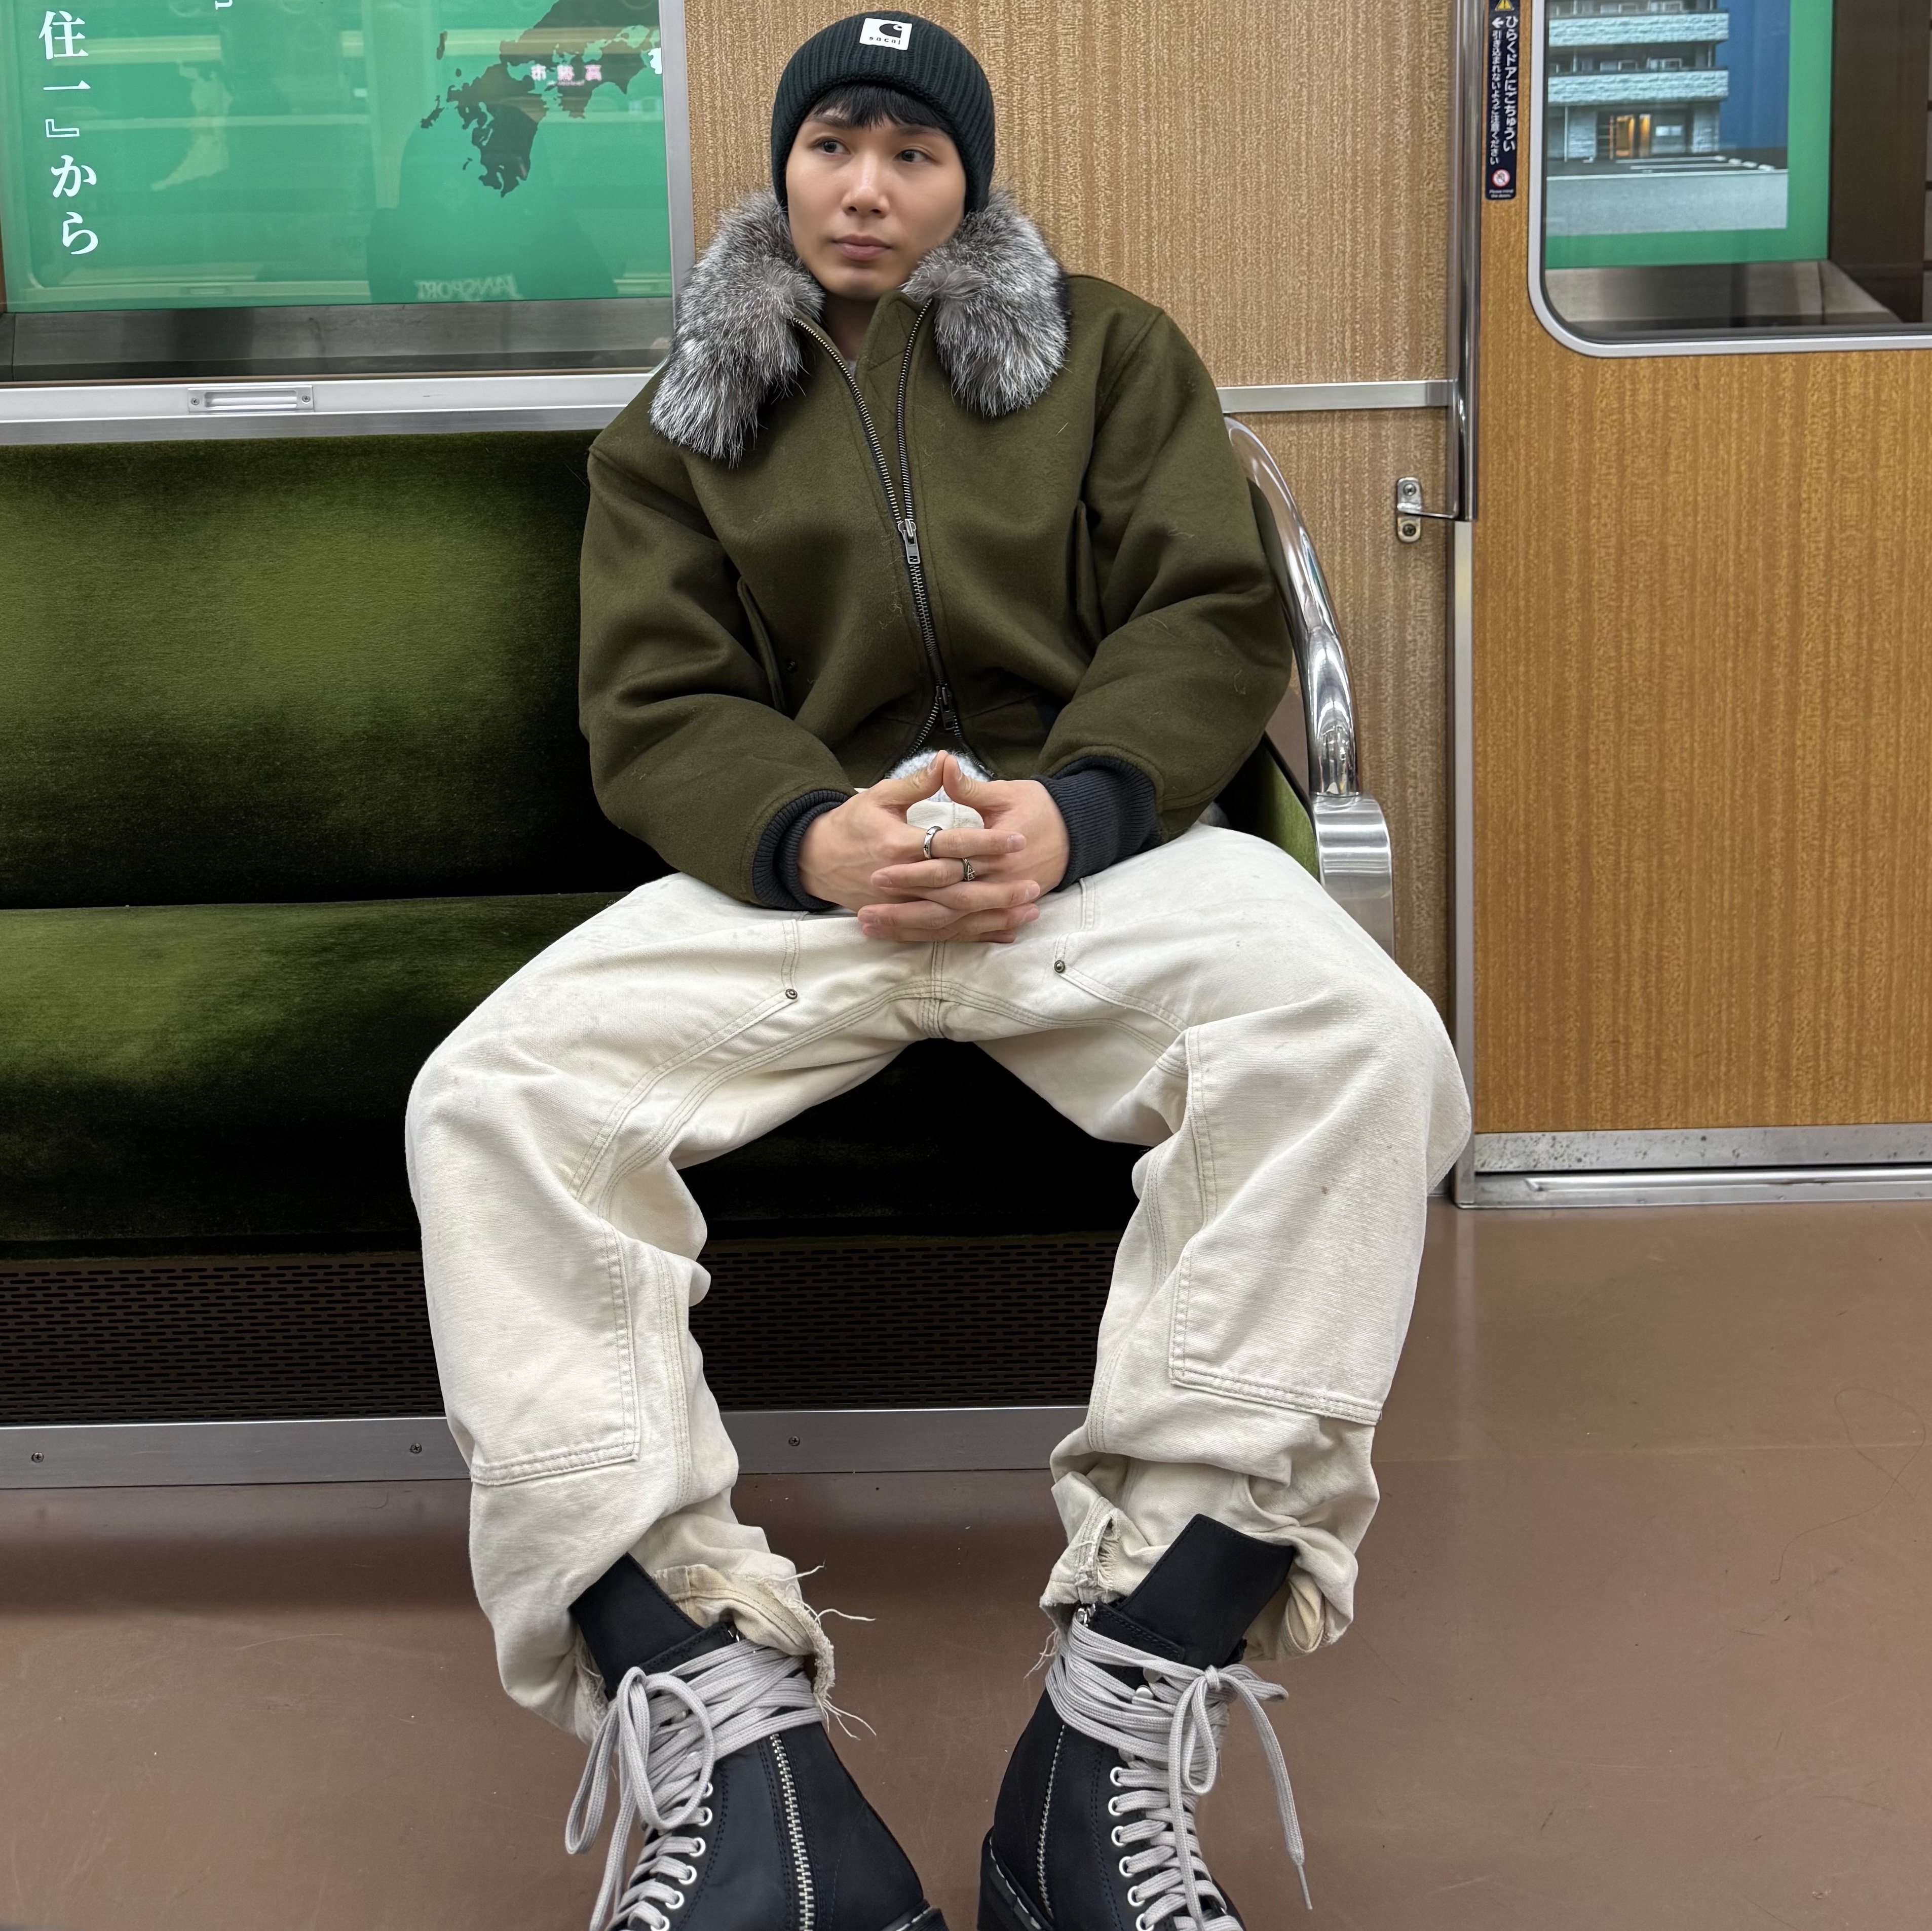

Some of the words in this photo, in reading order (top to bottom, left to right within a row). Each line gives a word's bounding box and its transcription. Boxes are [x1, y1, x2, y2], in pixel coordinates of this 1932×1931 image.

[869, 36, 901, 45] sacai
[39, 10, 99, 255] 住一』から
